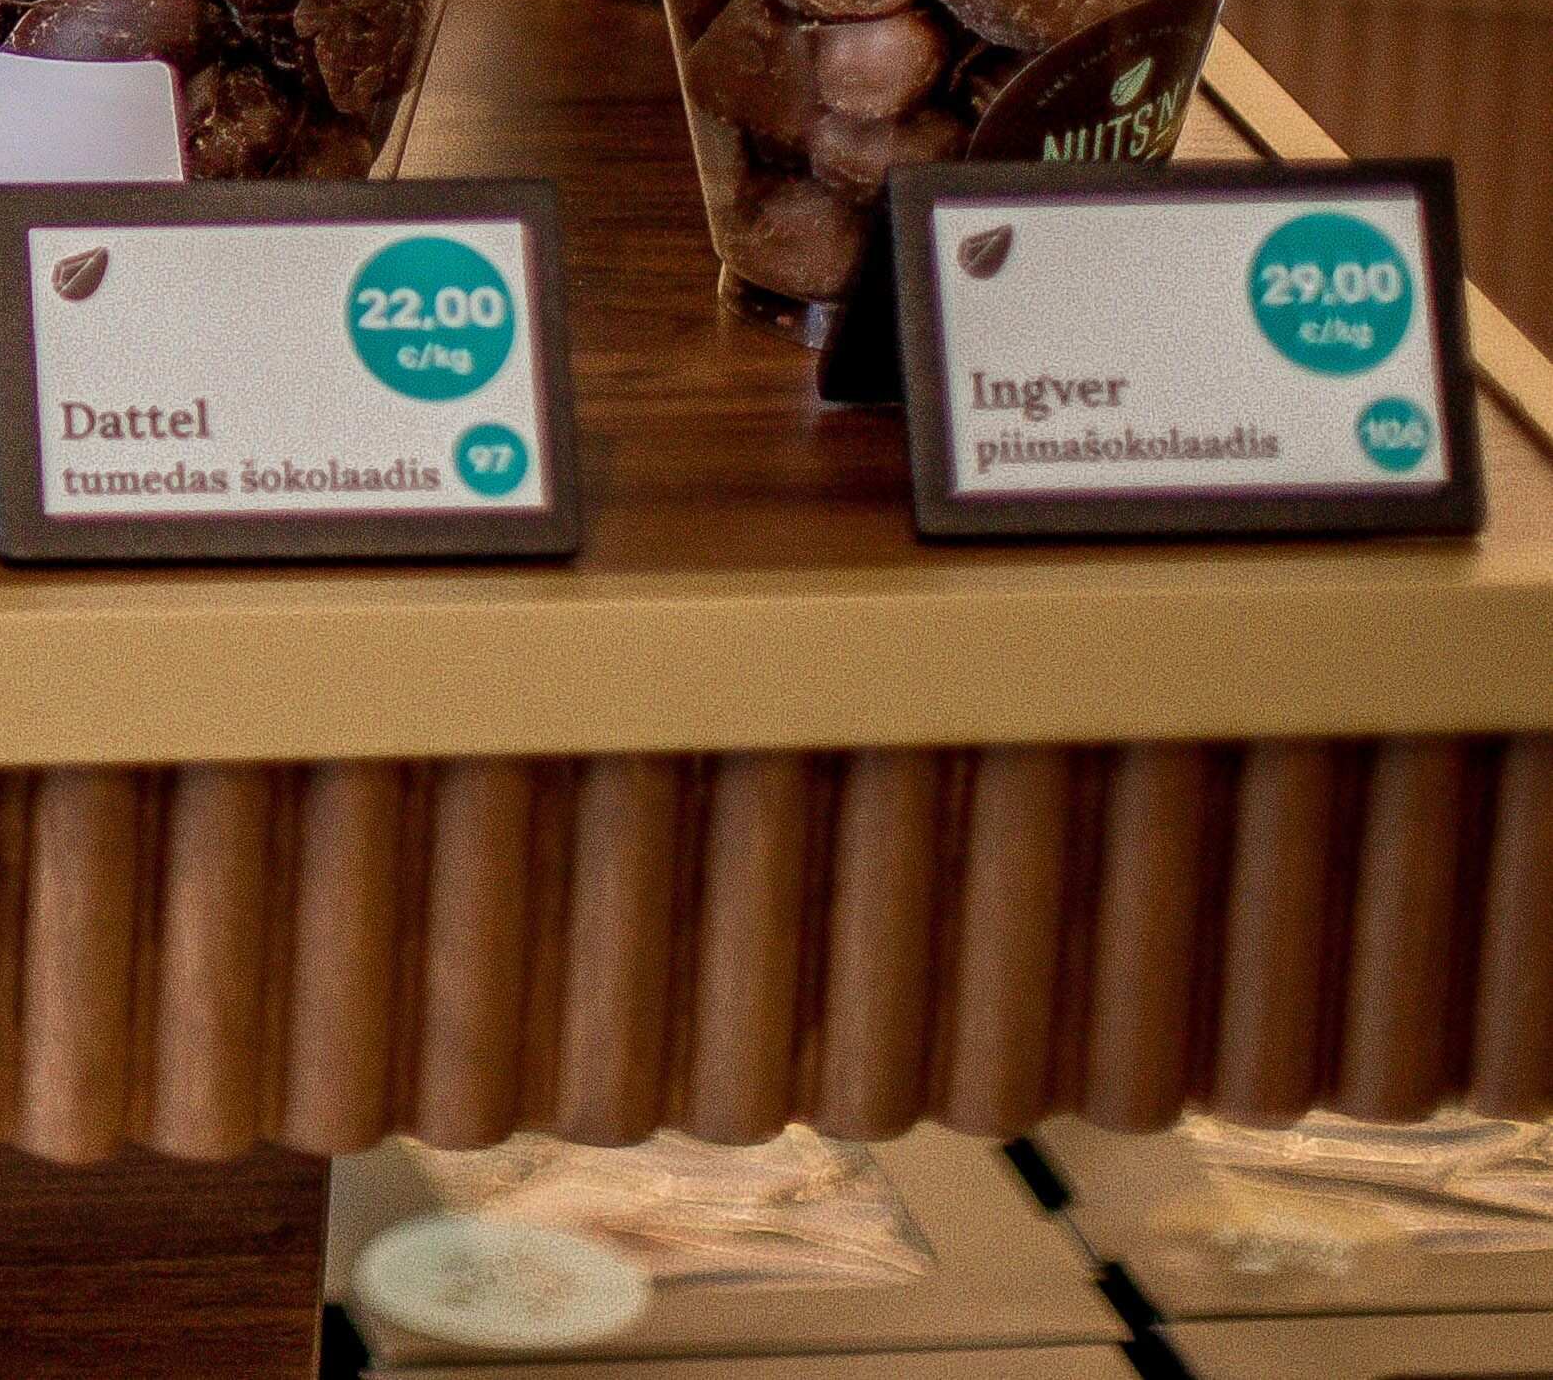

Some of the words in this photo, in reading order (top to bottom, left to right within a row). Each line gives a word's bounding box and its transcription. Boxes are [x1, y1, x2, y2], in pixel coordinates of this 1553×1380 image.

[970, 371, 1130, 422] Ingver
[60, 398, 210, 440] Dattel
[466, 443, 514, 474] 97
[976, 425, 1280, 475] piimašokolaadis
[62, 460, 229, 495] tumedas
[239, 457, 442, 492] šokolaadis
